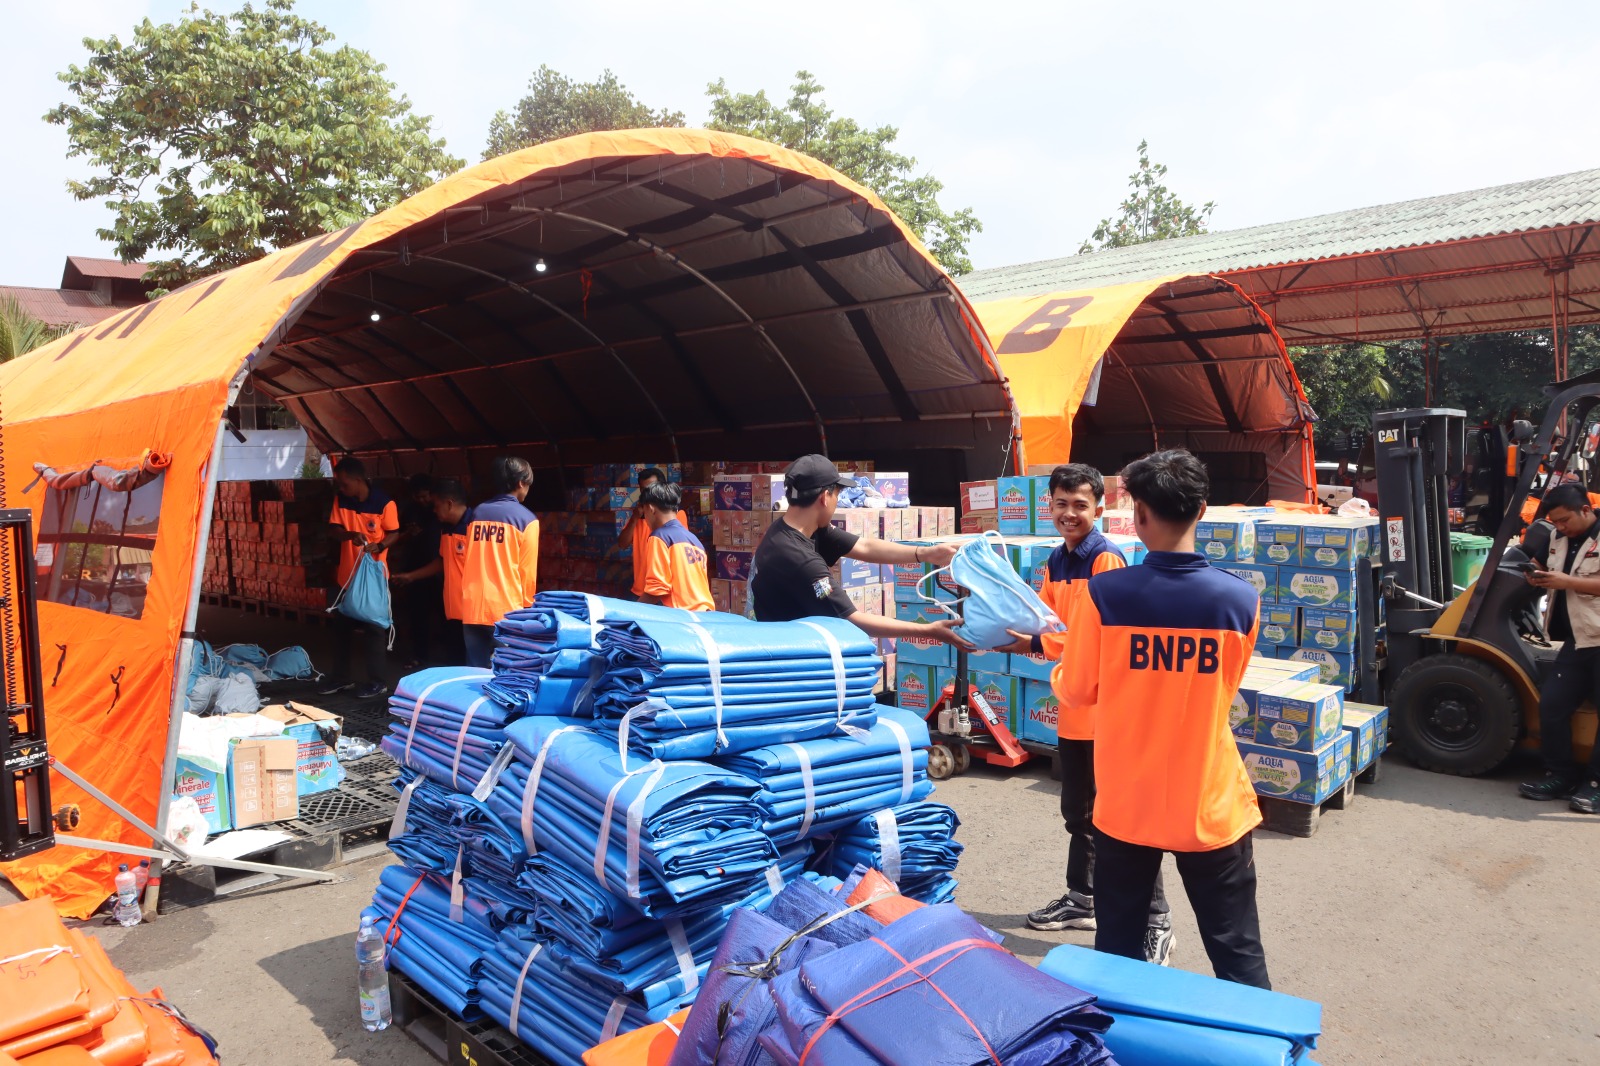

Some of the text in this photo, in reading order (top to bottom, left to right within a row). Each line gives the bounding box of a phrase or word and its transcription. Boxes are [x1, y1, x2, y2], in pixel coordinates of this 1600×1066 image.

[996, 296, 1094, 354] B
[1378, 429, 1399, 442] CAT
[473, 525, 505, 543] BNPB
[1234, 570, 1253, 579] AQUA
[1303, 575, 1325, 584] AQUA
[1129, 633, 1220, 674] BNPB
[1302, 651, 1326, 662] AQUA
[900, 681, 925, 690] Minerale
[988, 687, 996, 695] Le
[1046, 700, 1058, 714] Le
[1258, 756, 1284, 768] AQUA
[181, 775, 194, 786] Le
[176, 781, 210, 794] inerale
